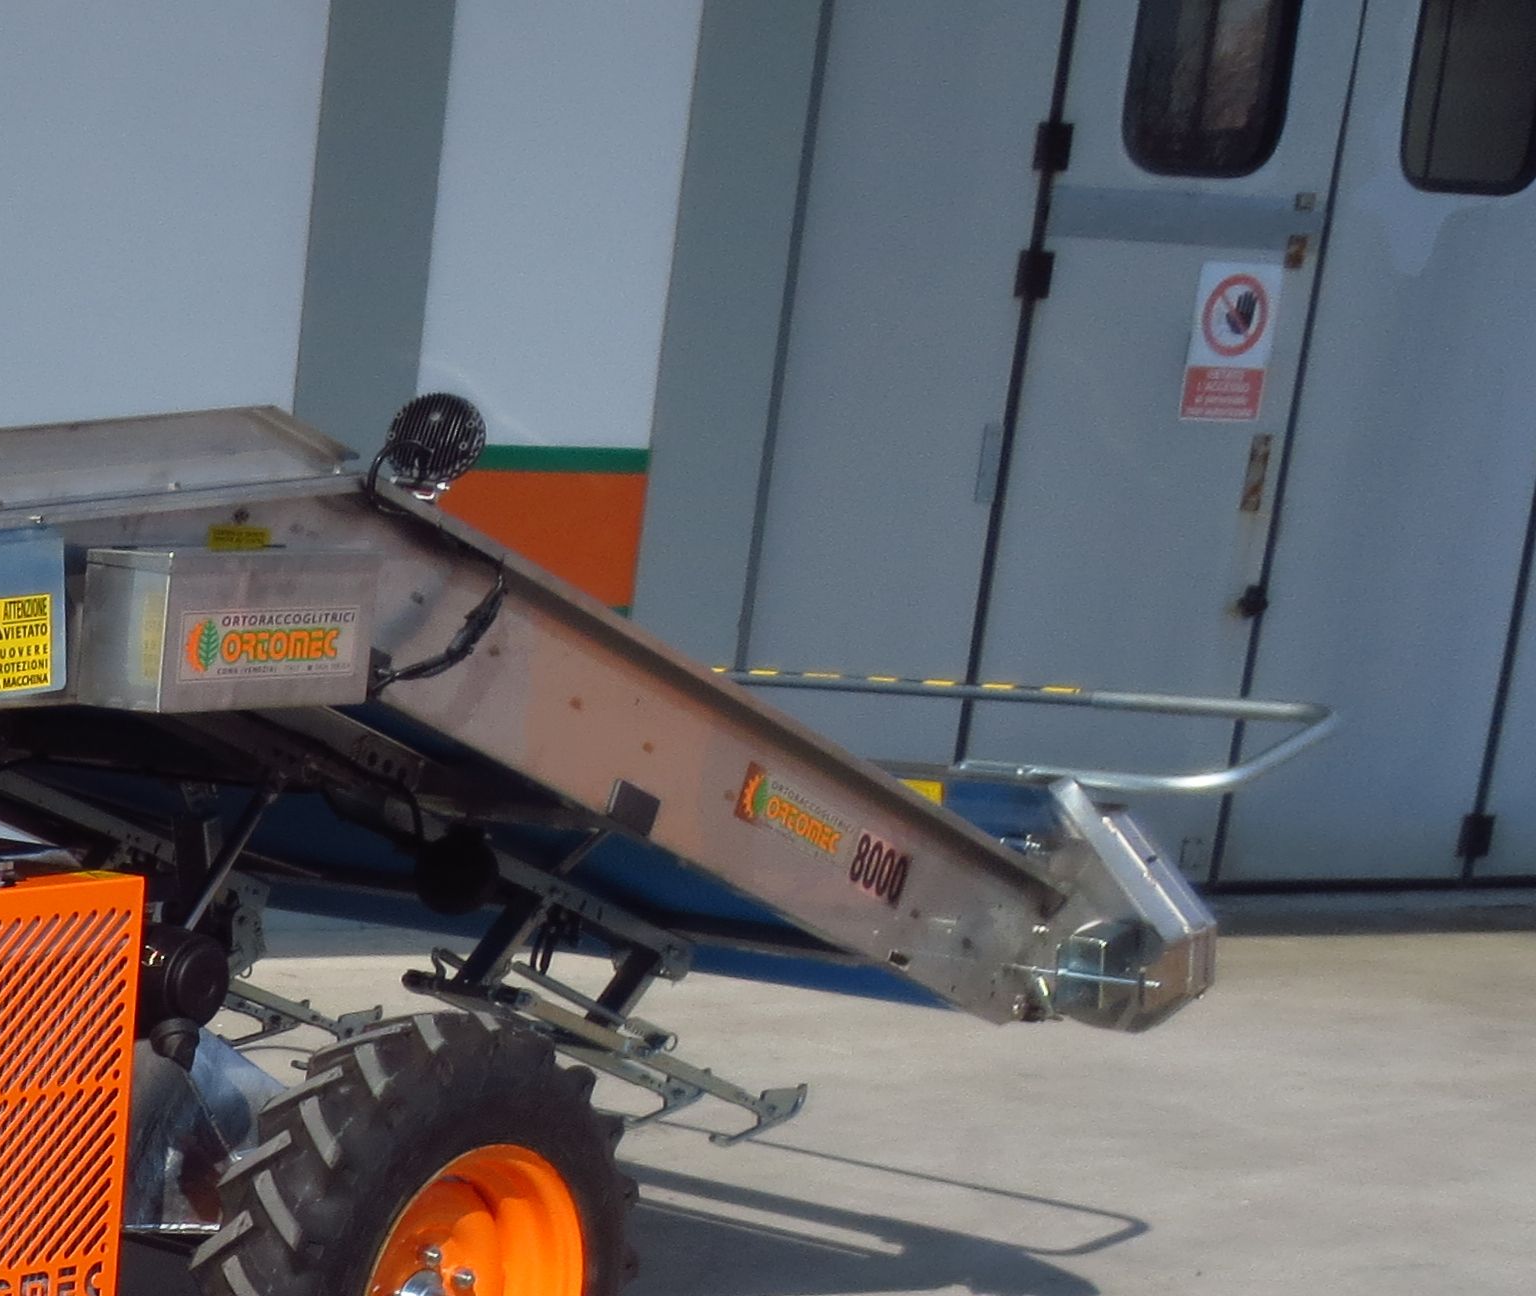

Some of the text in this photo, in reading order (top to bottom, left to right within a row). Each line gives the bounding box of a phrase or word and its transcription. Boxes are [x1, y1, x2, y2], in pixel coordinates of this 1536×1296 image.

[3, 597, 47, 620] ATTENZIONE
[3, 623, 48, 640] VIETATO
[220, 628, 341, 663] ORTOMEC
[3, 674, 48, 688] MACCHINA
[766, 796, 842, 855] ORTOMEC
[849, 833, 910, 907] 8000
